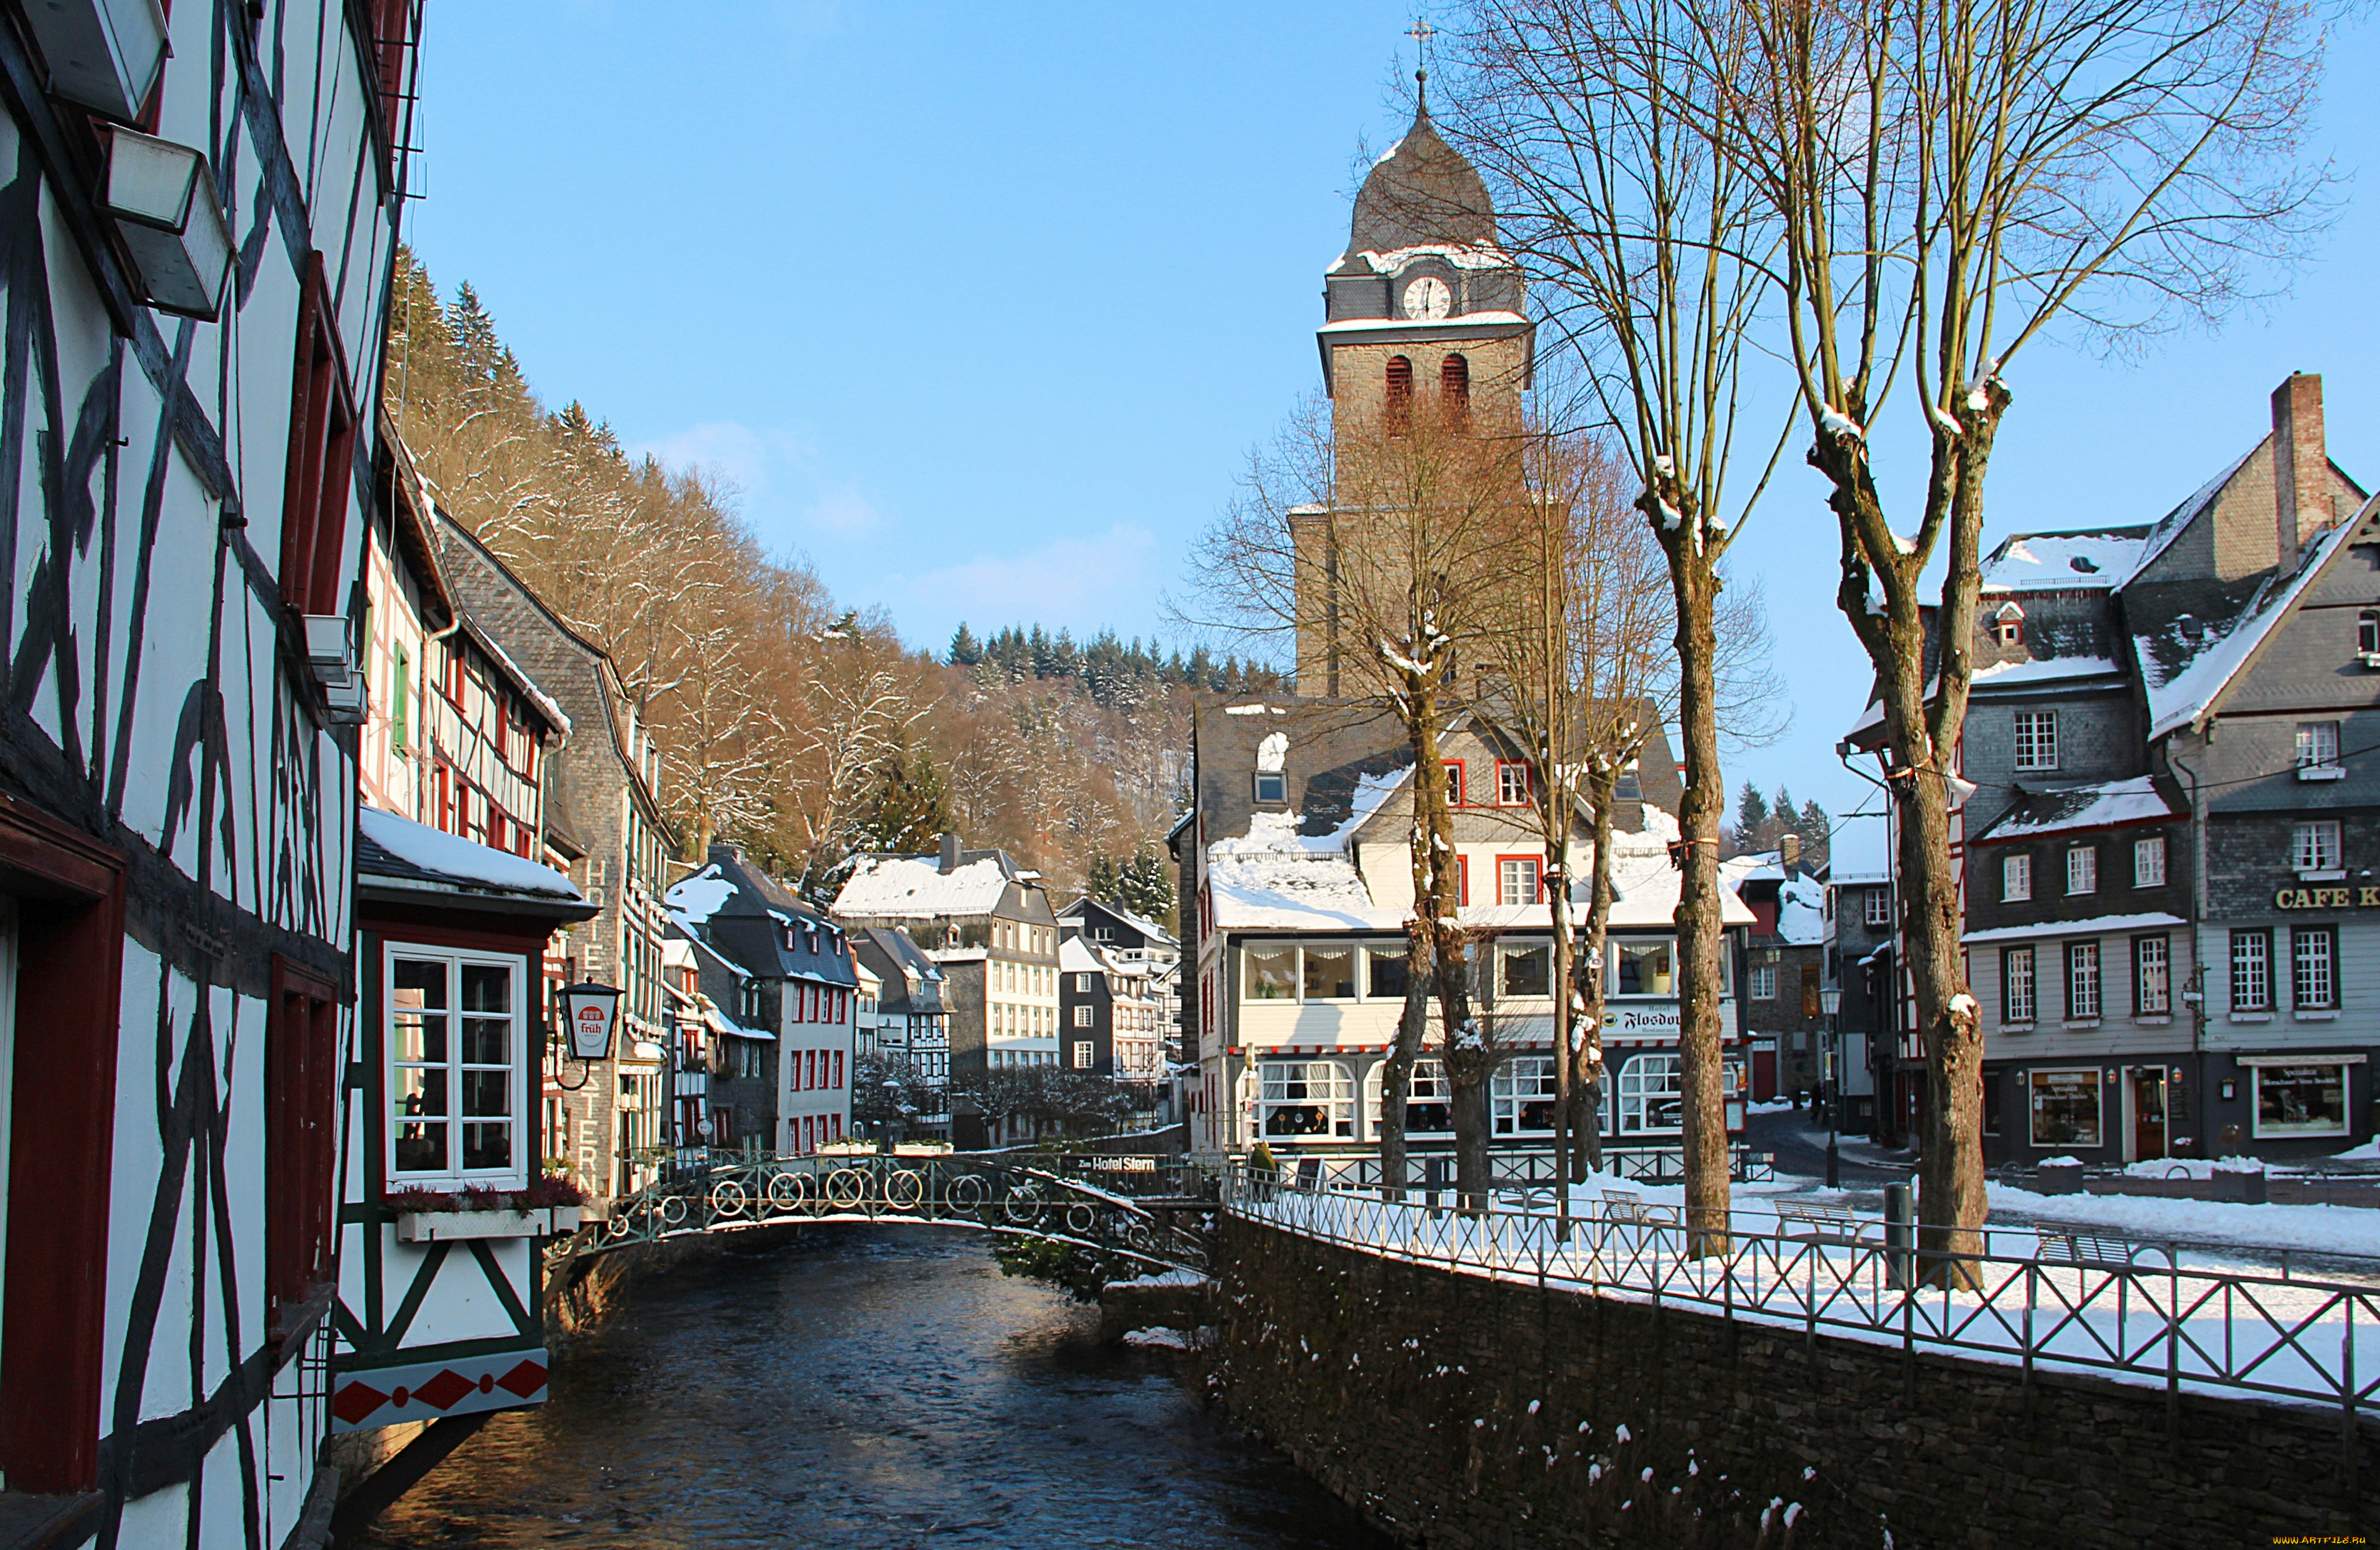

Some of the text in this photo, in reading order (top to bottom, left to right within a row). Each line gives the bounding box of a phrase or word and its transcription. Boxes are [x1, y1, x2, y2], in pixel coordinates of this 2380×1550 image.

[2276, 887, 2351, 909] CAFE
[581, 1022, 602, 1034] früh
[1624, 1011, 1680, 1030] Flosdor
[1093, 1157, 1123, 1171] Hotel
[1123, 1157, 1155, 1171] Stern
